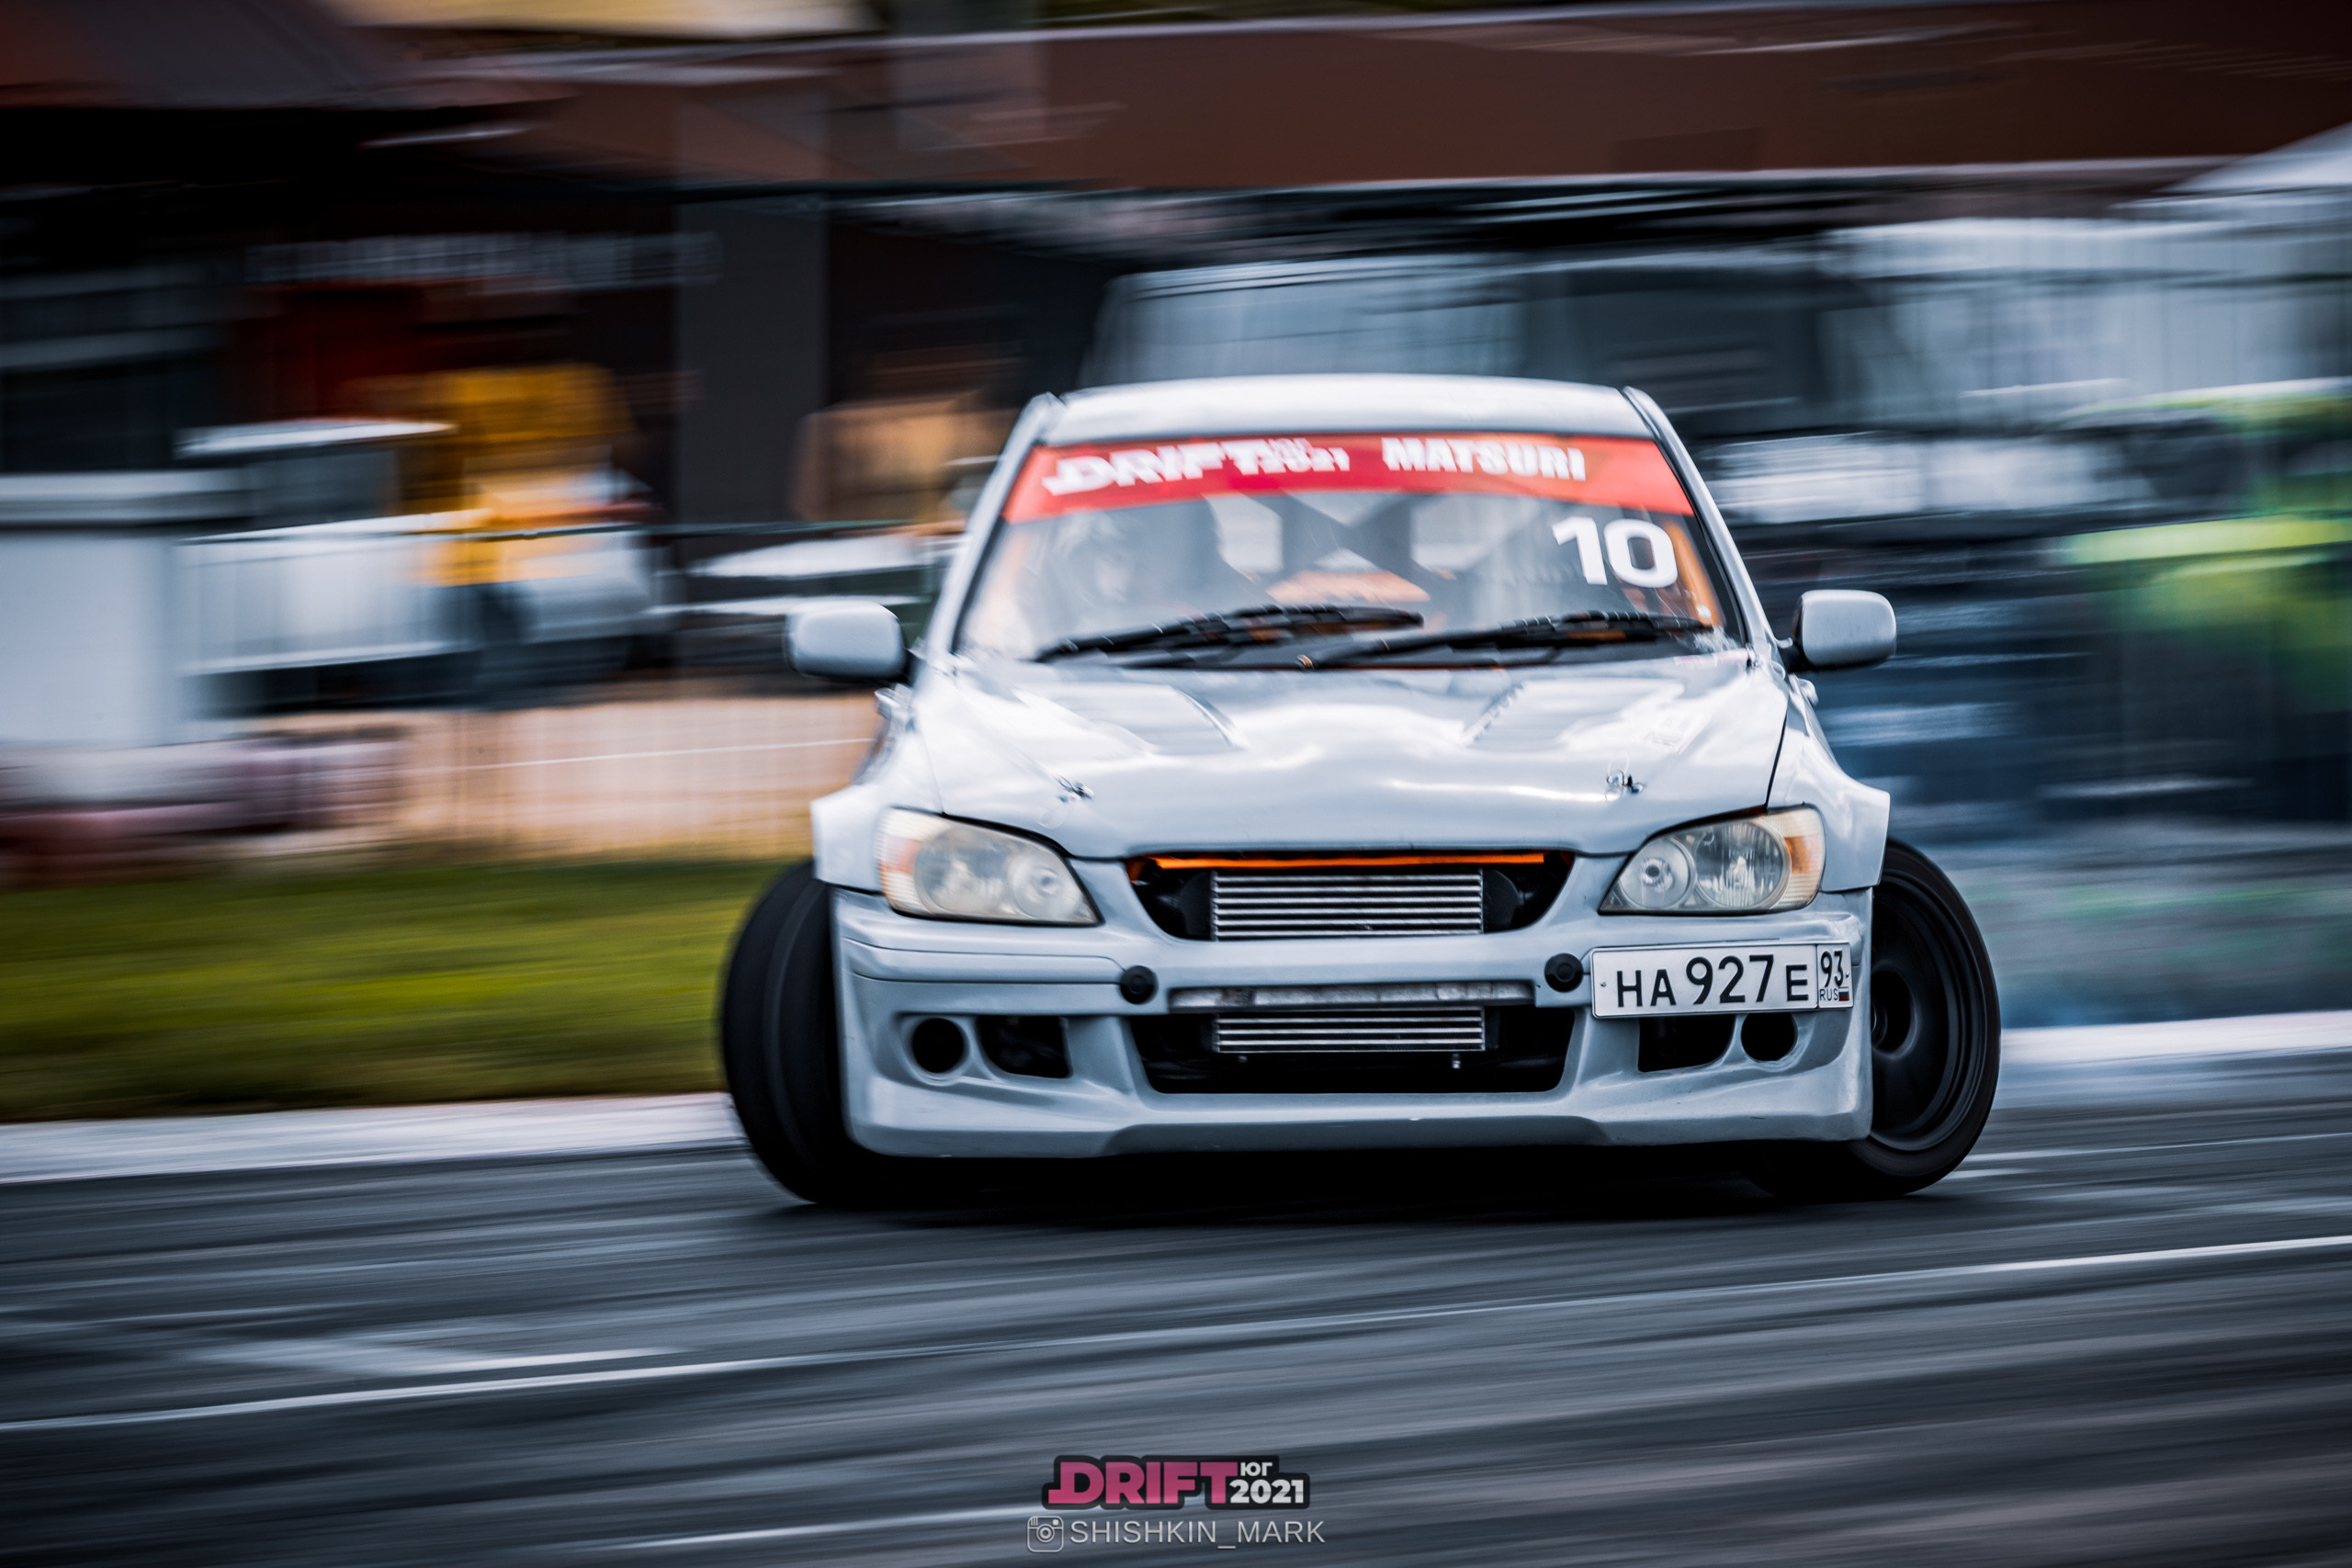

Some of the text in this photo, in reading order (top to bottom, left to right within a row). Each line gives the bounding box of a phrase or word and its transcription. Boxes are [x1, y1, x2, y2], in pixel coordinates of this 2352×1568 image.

[1042, 439, 1272, 496] DRIFT
[1381, 436, 1587, 481] MATSURI
[1552, 516, 1678, 588] 10
[1820, 950, 1844, 988] 93
[1819, 987, 1838, 1002] RUS
